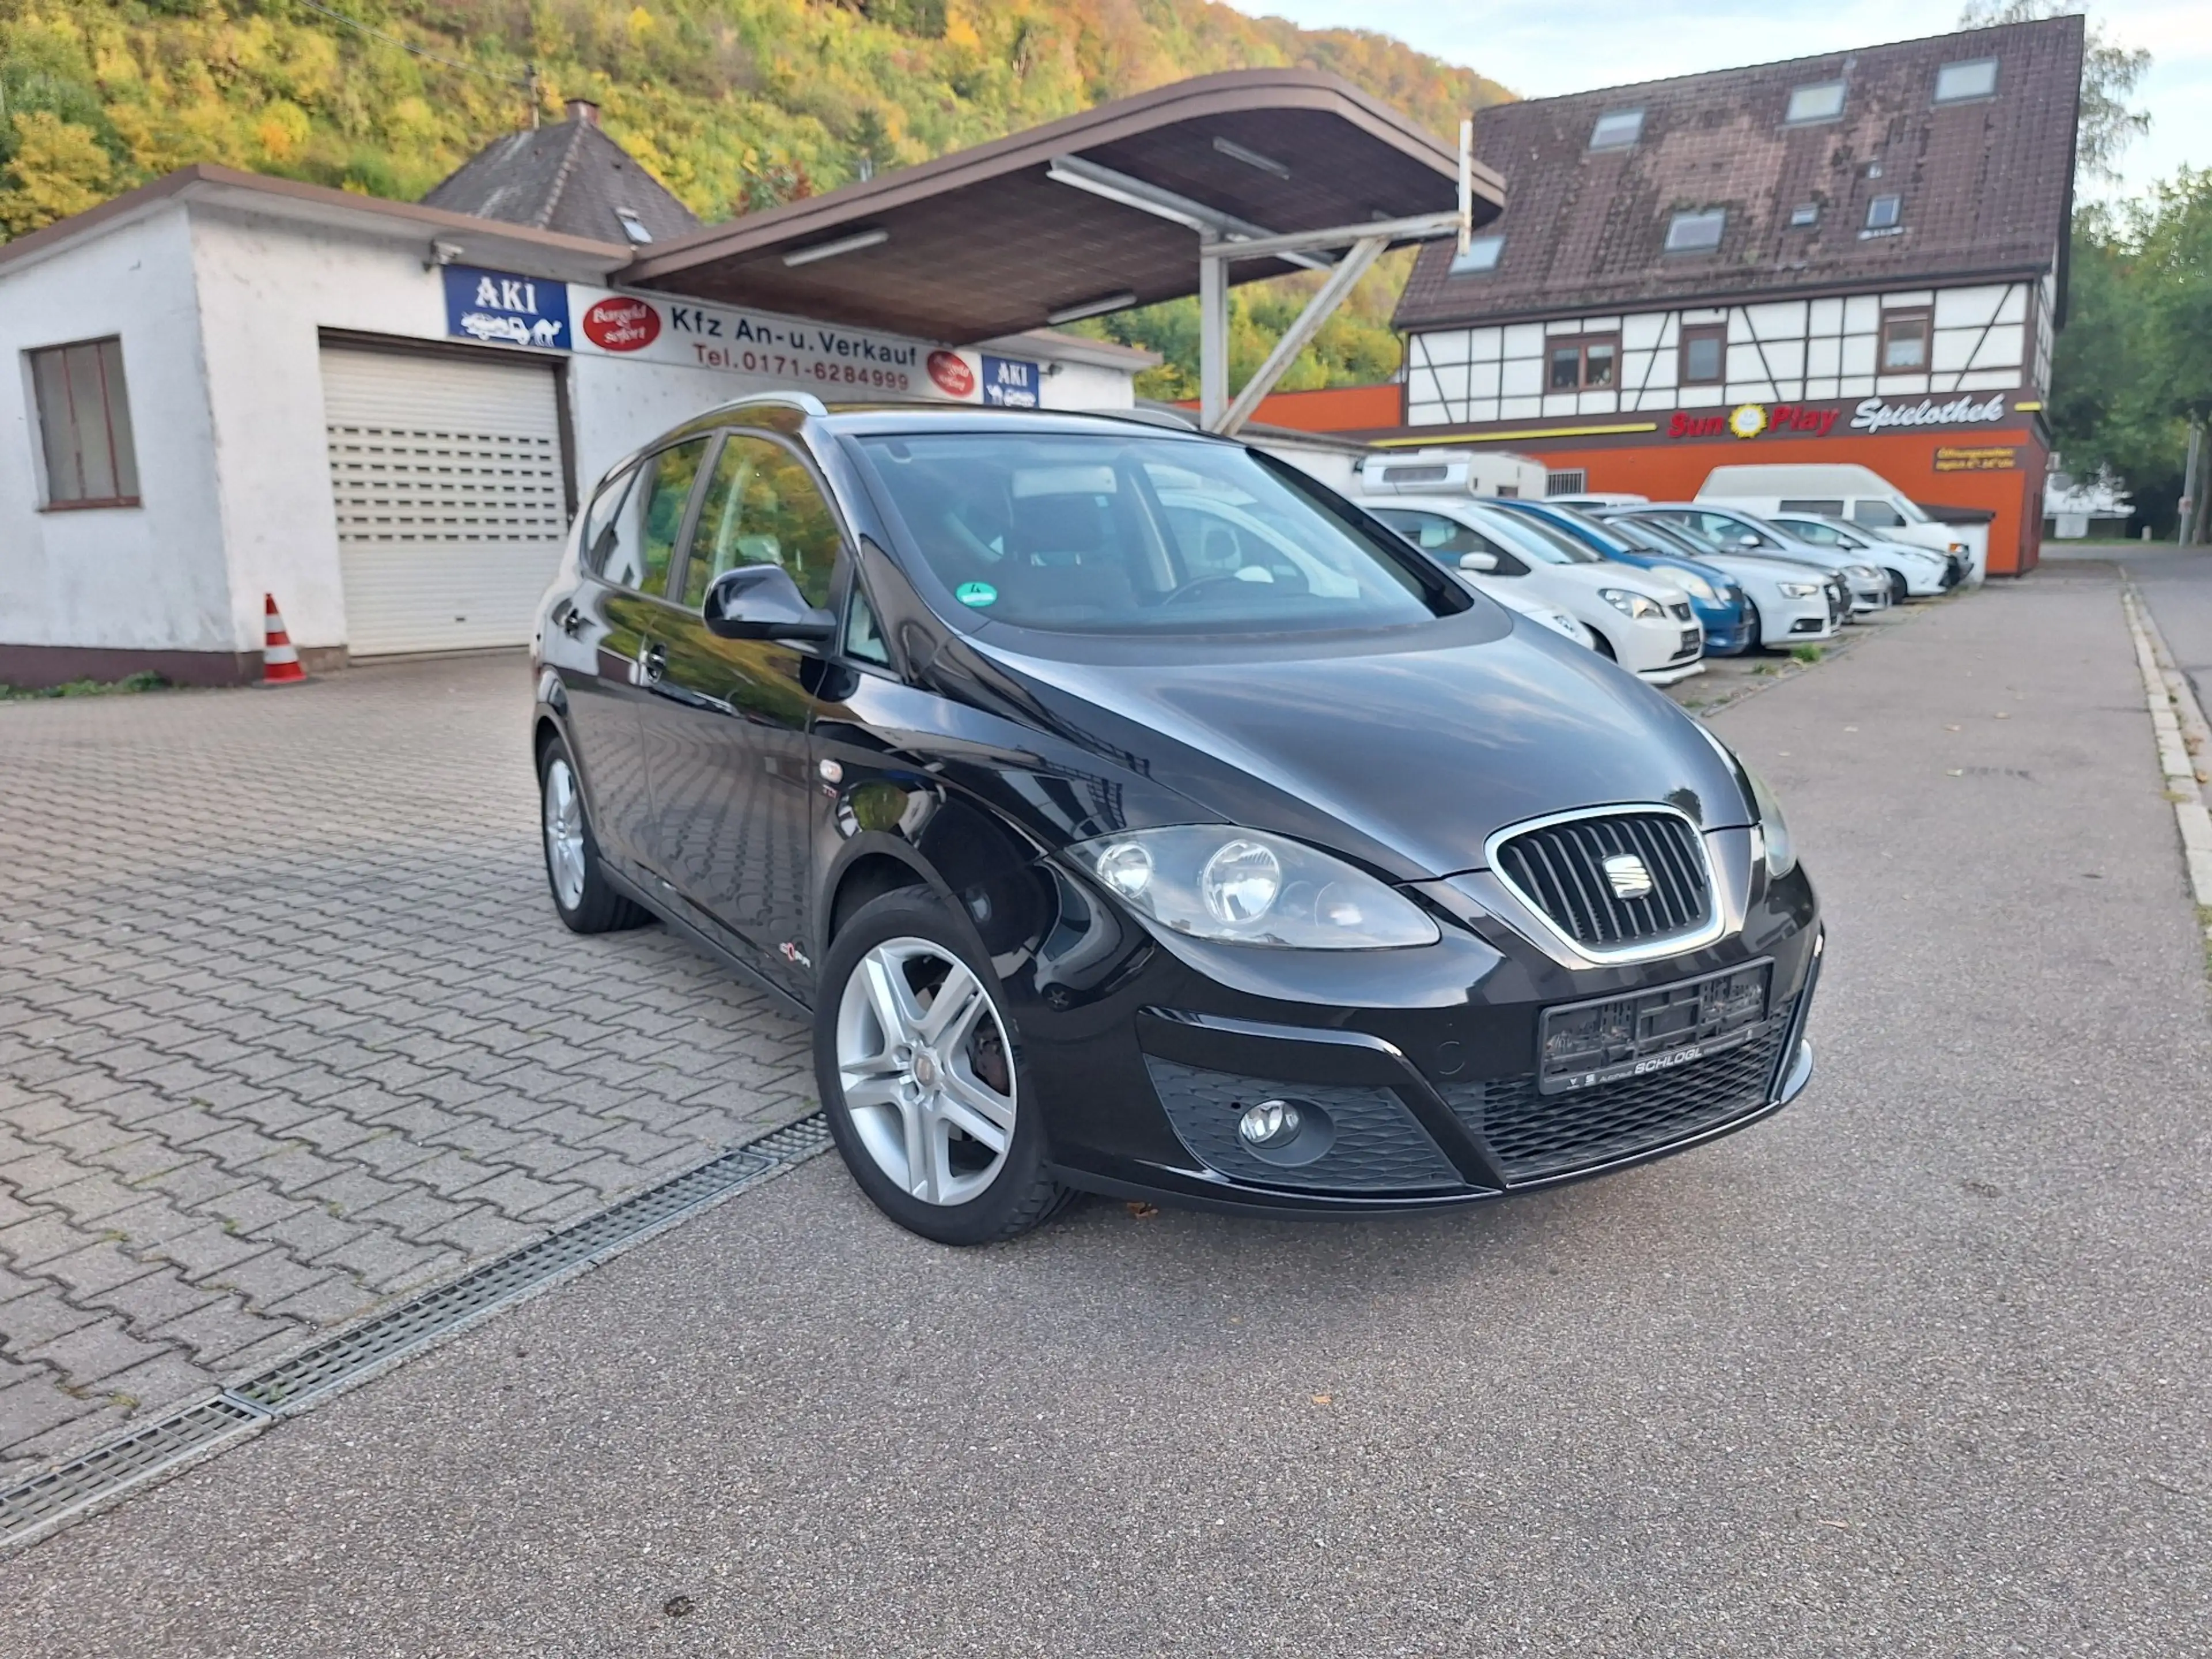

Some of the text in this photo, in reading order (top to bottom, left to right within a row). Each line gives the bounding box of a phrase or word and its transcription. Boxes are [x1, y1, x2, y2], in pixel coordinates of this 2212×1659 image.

[671, 306, 722, 338] Kfz
[998, 361, 1028, 387] AKI
[1667, 393, 2005, 437] Sun Play Spielothek
